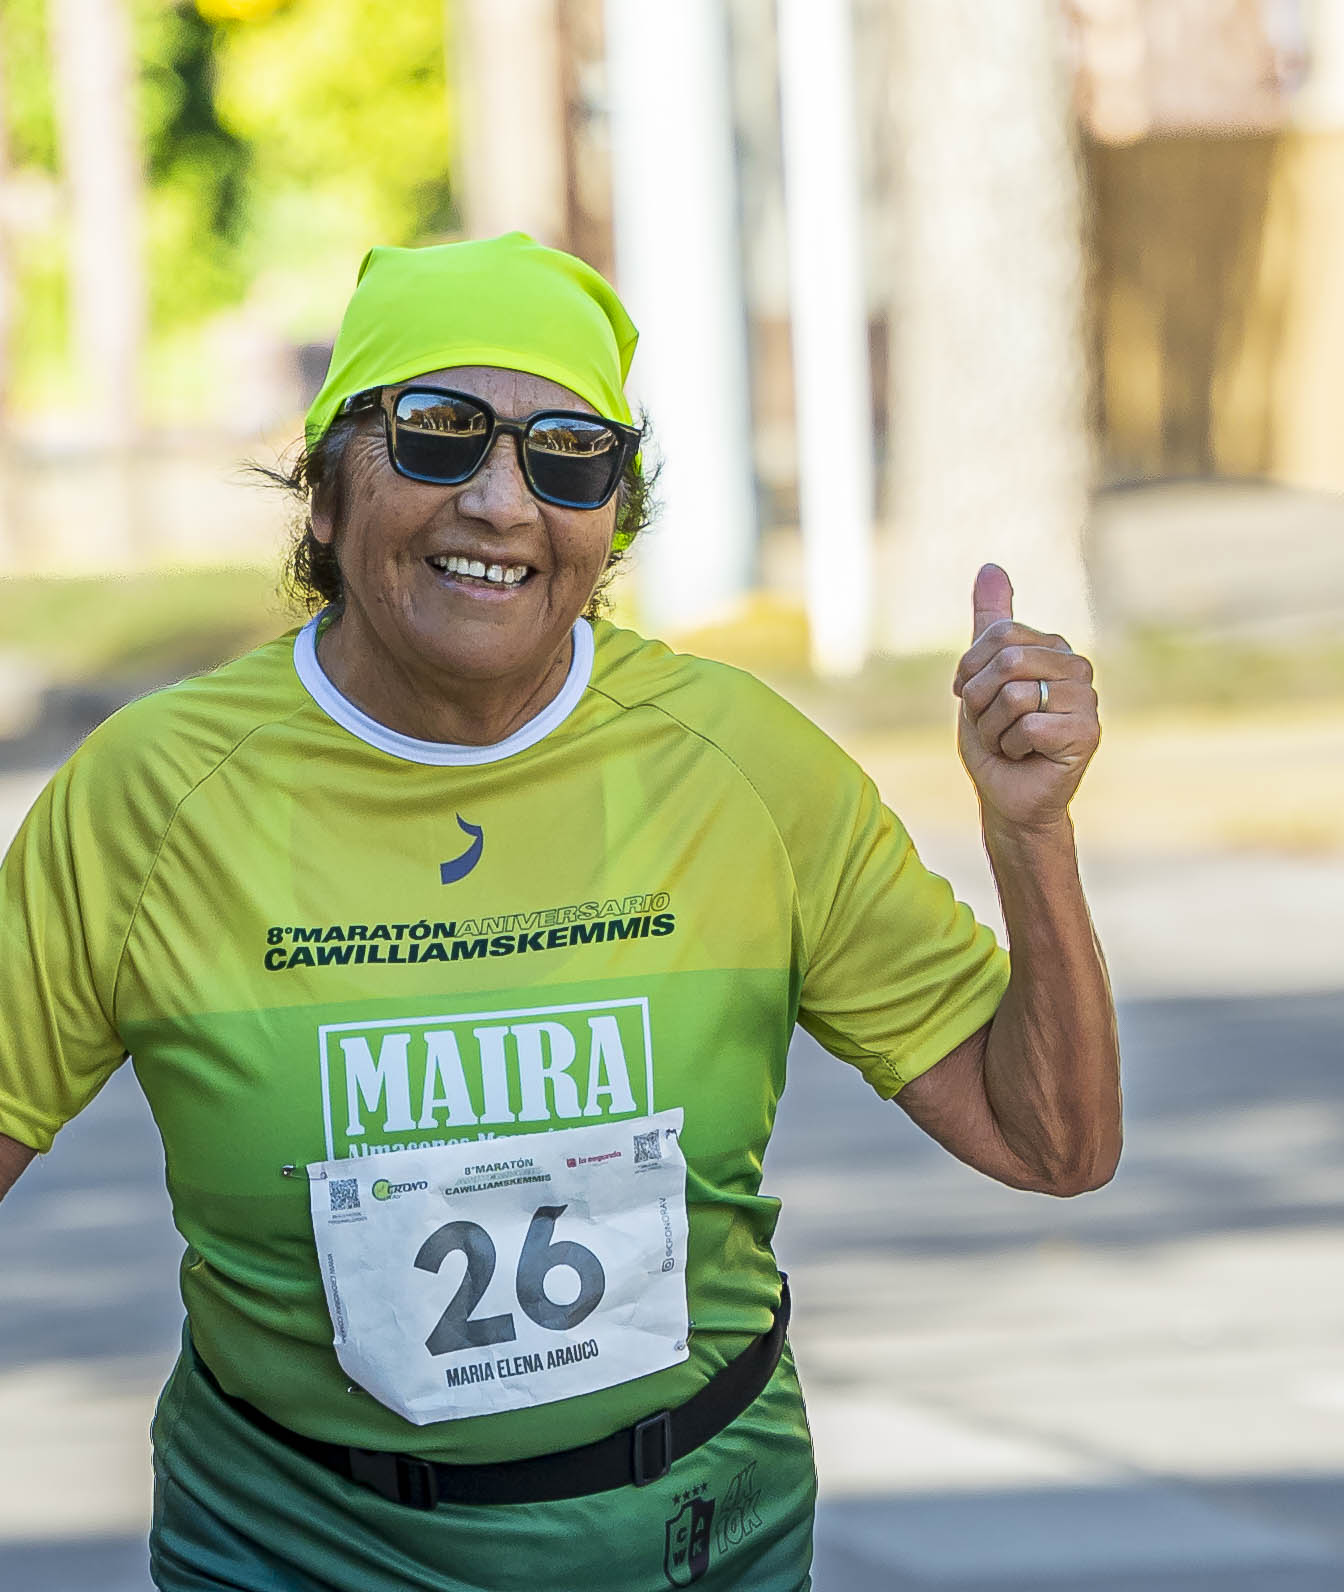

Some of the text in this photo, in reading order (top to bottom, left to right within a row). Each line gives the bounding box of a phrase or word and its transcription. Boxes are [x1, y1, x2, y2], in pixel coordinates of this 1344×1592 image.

[264, 912, 675, 971] CAWILLIAMSKEMMIS
[456, 892, 670, 937] ANIVERSARIO
[339, 1015, 637, 1136] MAIRA
[413, 1204, 606, 1356] 26
[445, 1338, 599, 1388] MARIA ELENA ARAUCO
